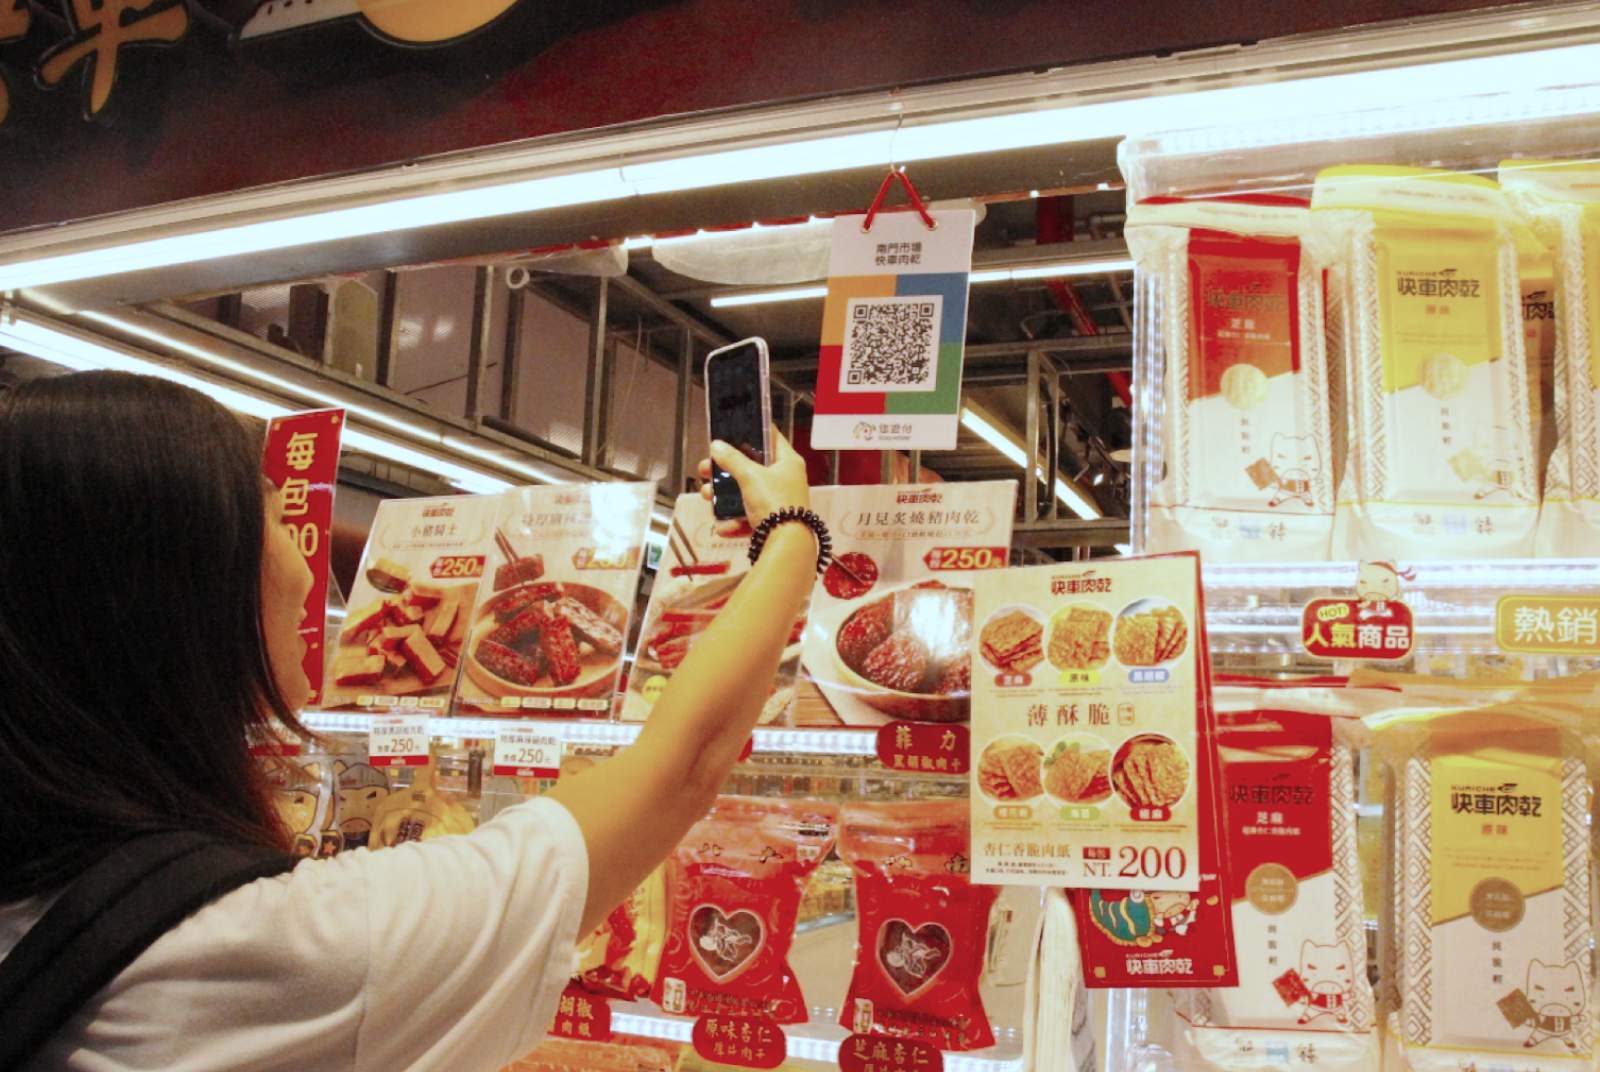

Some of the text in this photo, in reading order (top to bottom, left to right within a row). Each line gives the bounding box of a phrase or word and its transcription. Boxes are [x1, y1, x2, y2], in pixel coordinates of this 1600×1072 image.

[1397, 278, 1480, 298] 快車肉乾
[1051, 577, 1112, 596] 快車肉乾
[1304, 622, 1410, 649] 人氣商品
[1514, 606, 1598, 644] 熱銷
[1028, 703, 1111, 727] 薄酥脆
[1230, 785, 1314, 805] 快車肉乾
[1451, 792, 1542, 818] 快車肉乾
[1083, 862, 1112, 877] NT.
[1119, 845, 1187, 879] 200
[1126, 958, 1193, 975] 快車肉乾
[705, 1018, 772, 1043] 原味杏仁
[853, 1038, 928, 1064] 芝麻杏仁
